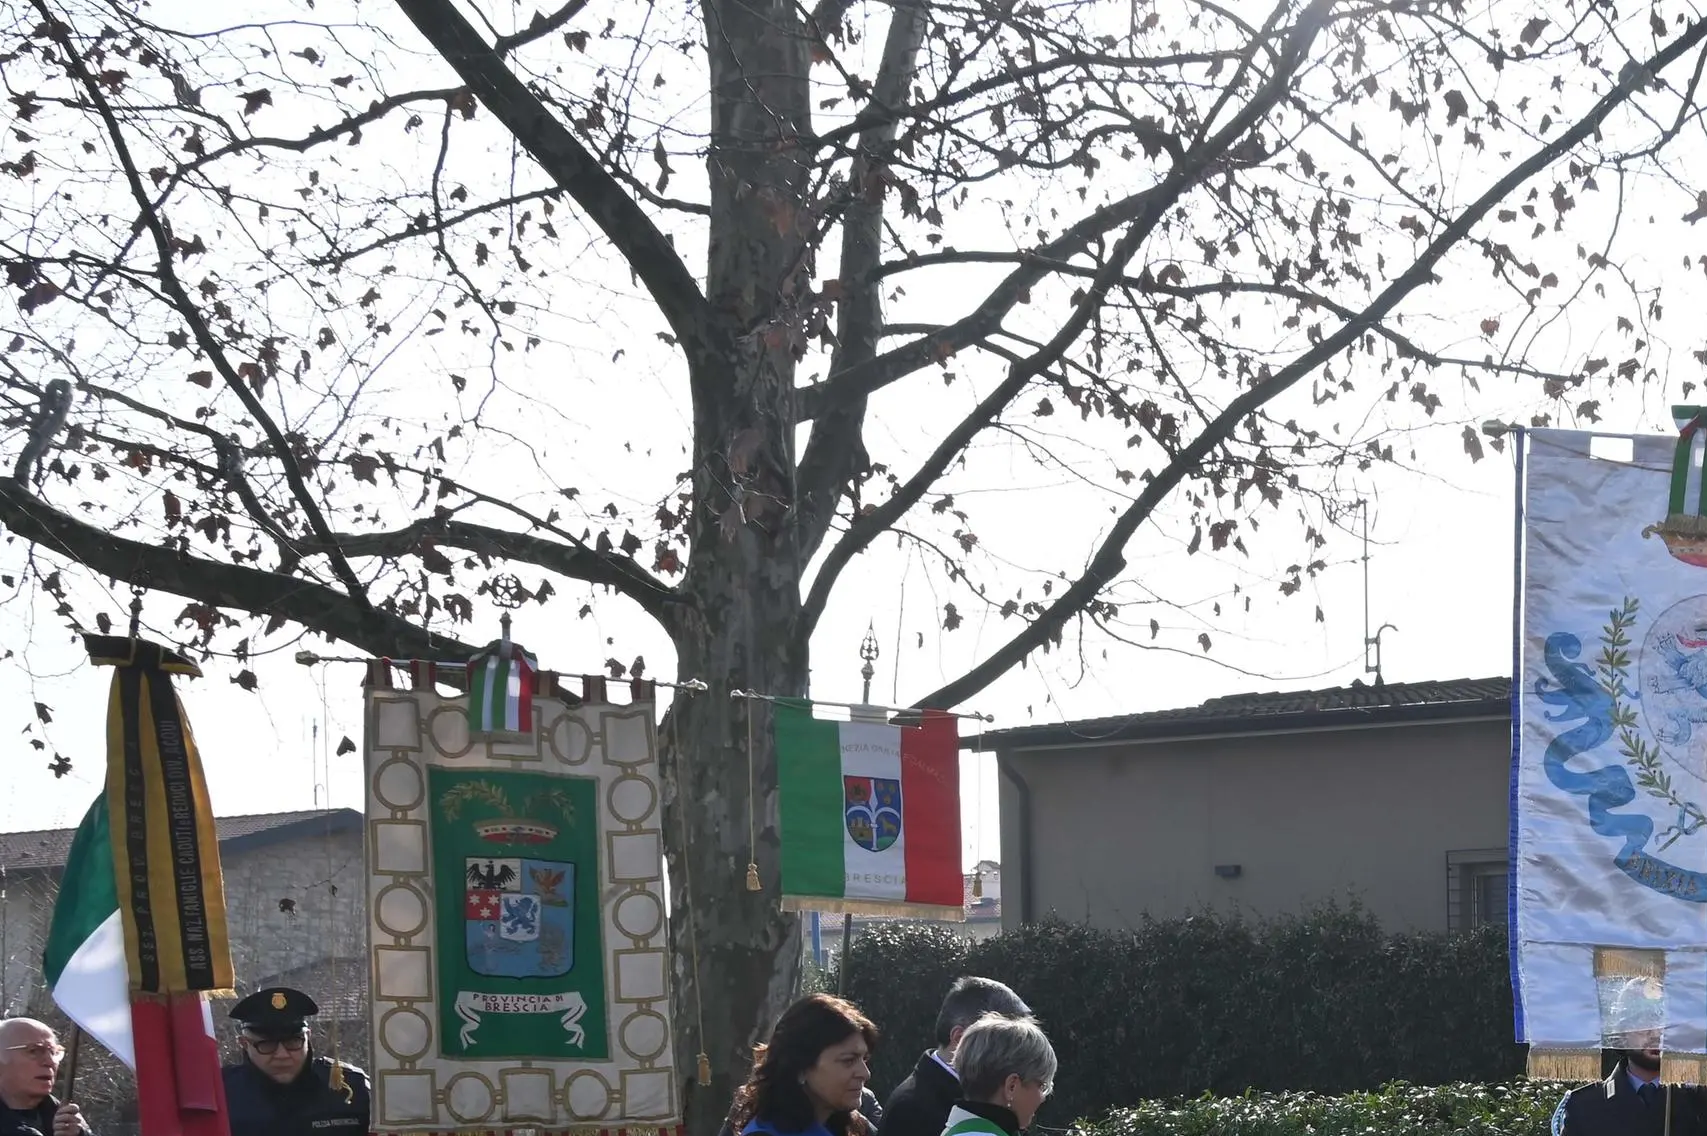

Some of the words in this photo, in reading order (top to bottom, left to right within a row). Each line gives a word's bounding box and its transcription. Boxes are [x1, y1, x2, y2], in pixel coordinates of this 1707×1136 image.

[168, 782, 190, 819] REDUCI
[174, 826, 195, 864] CADUTI
[177, 867, 200, 916] FAMIGLIE
[472, 993, 551, 1004] PROVINCIA
[555, 994, 564, 1003] DI
[485, 1002, 549, 1013] BRESCIA
